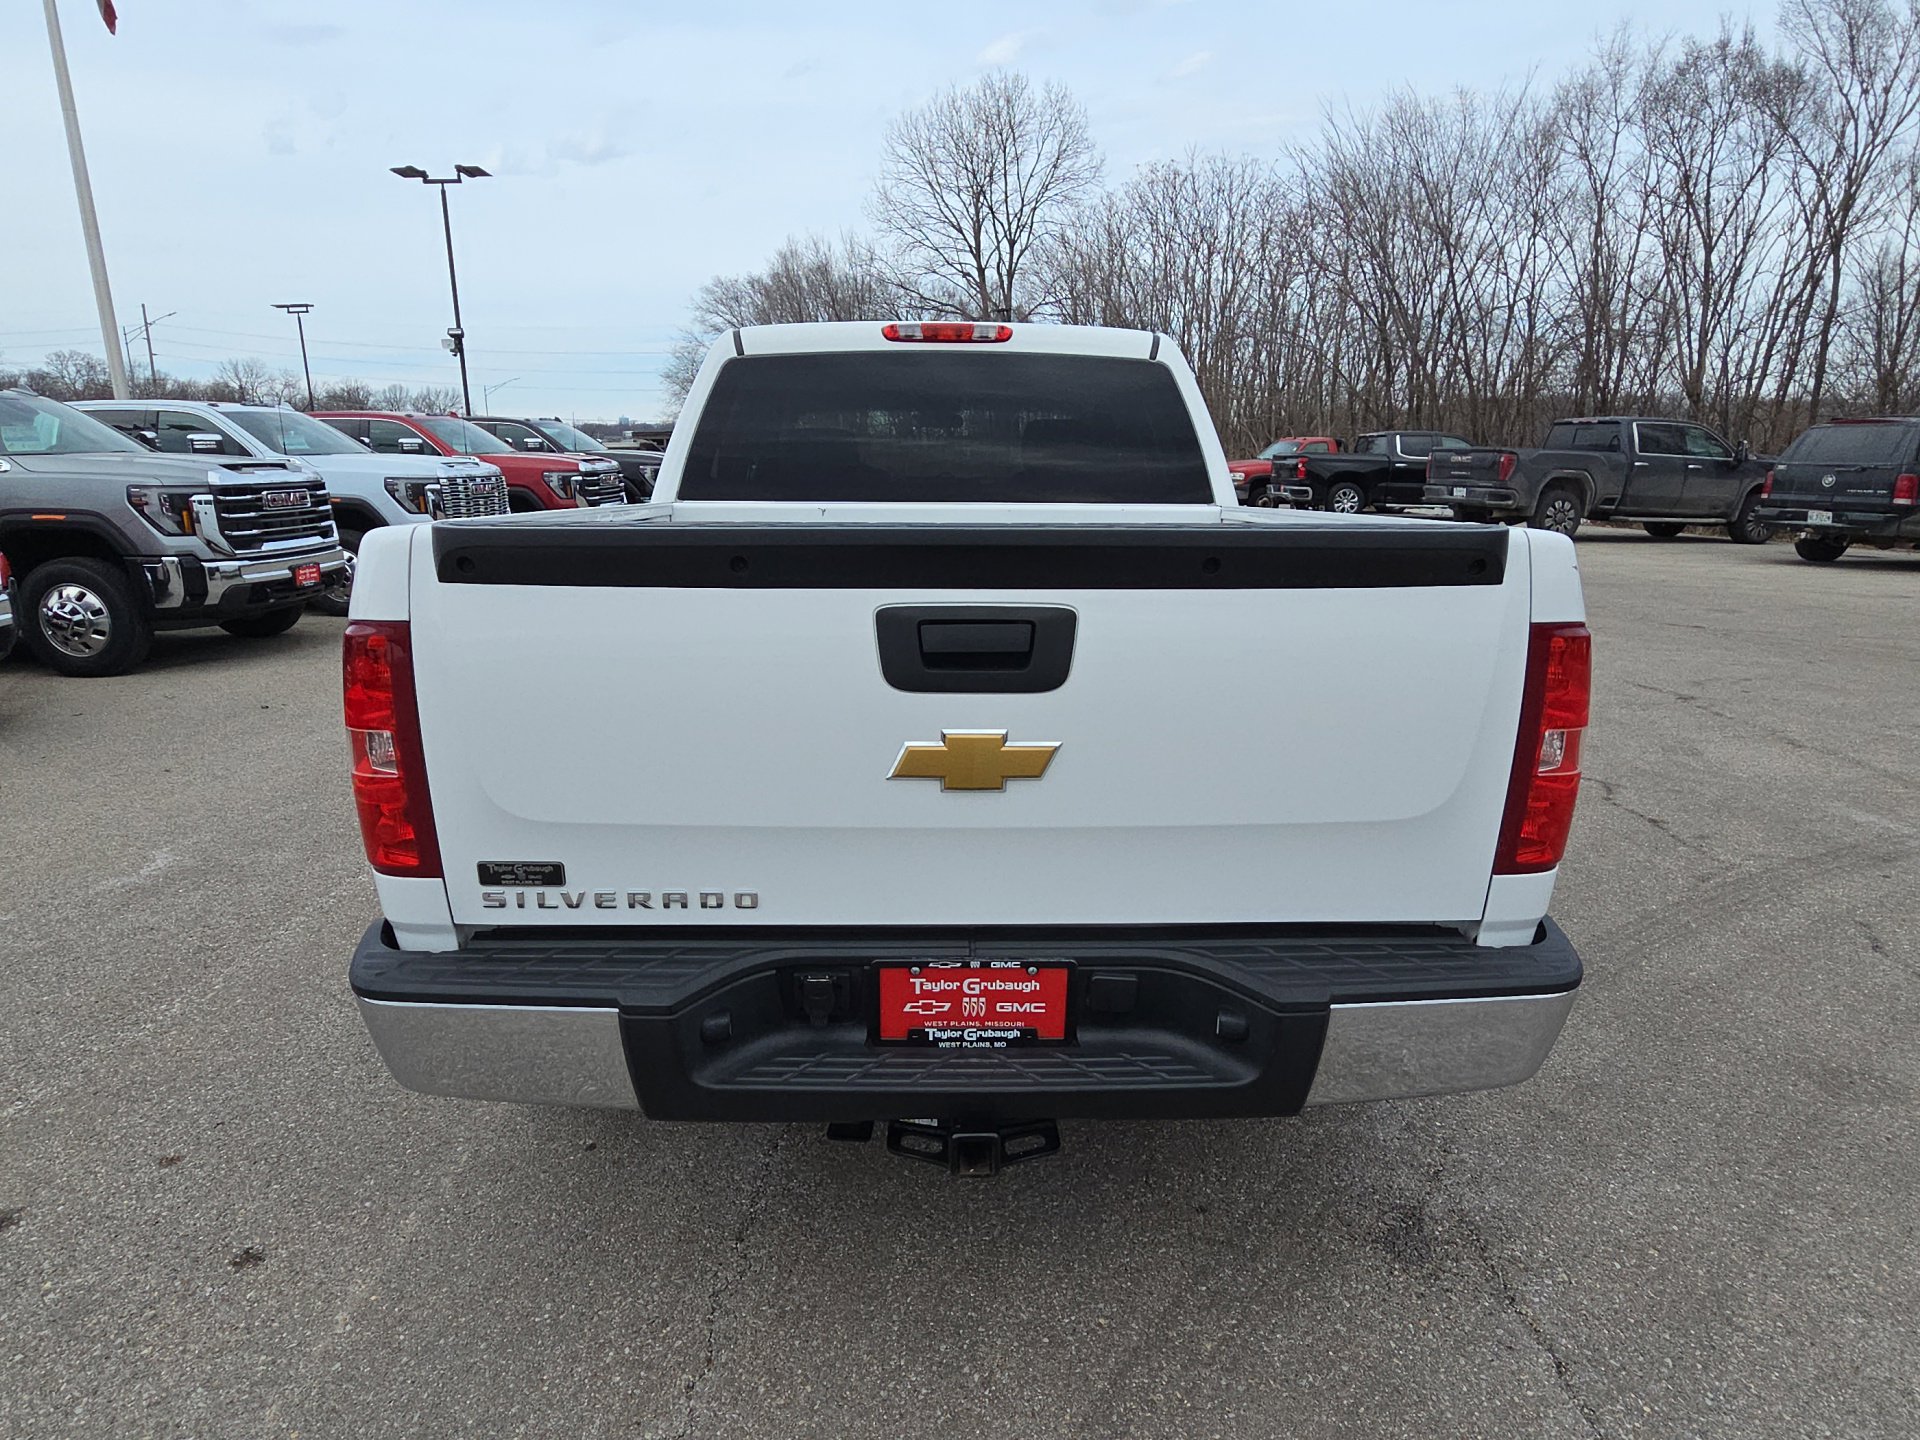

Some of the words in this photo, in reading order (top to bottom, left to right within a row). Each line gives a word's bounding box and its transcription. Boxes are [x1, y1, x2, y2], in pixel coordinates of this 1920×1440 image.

[487, 864, 513, 874] Taylor
[514, 864, 554, 874] Grubaugh
[482, 890, 759, 909] SILVERADO
[909, 978, 961, 995] Taylor
[962, 978, 1040, 995] Grubaugh
[996, 1002, 1046, 1013] GMC
[924, 1028, 962, 1041] Taylor
[963, 1028, 1021, 1041] Grubaugh
[962, 1041, 992, 1049] PLAINS,
